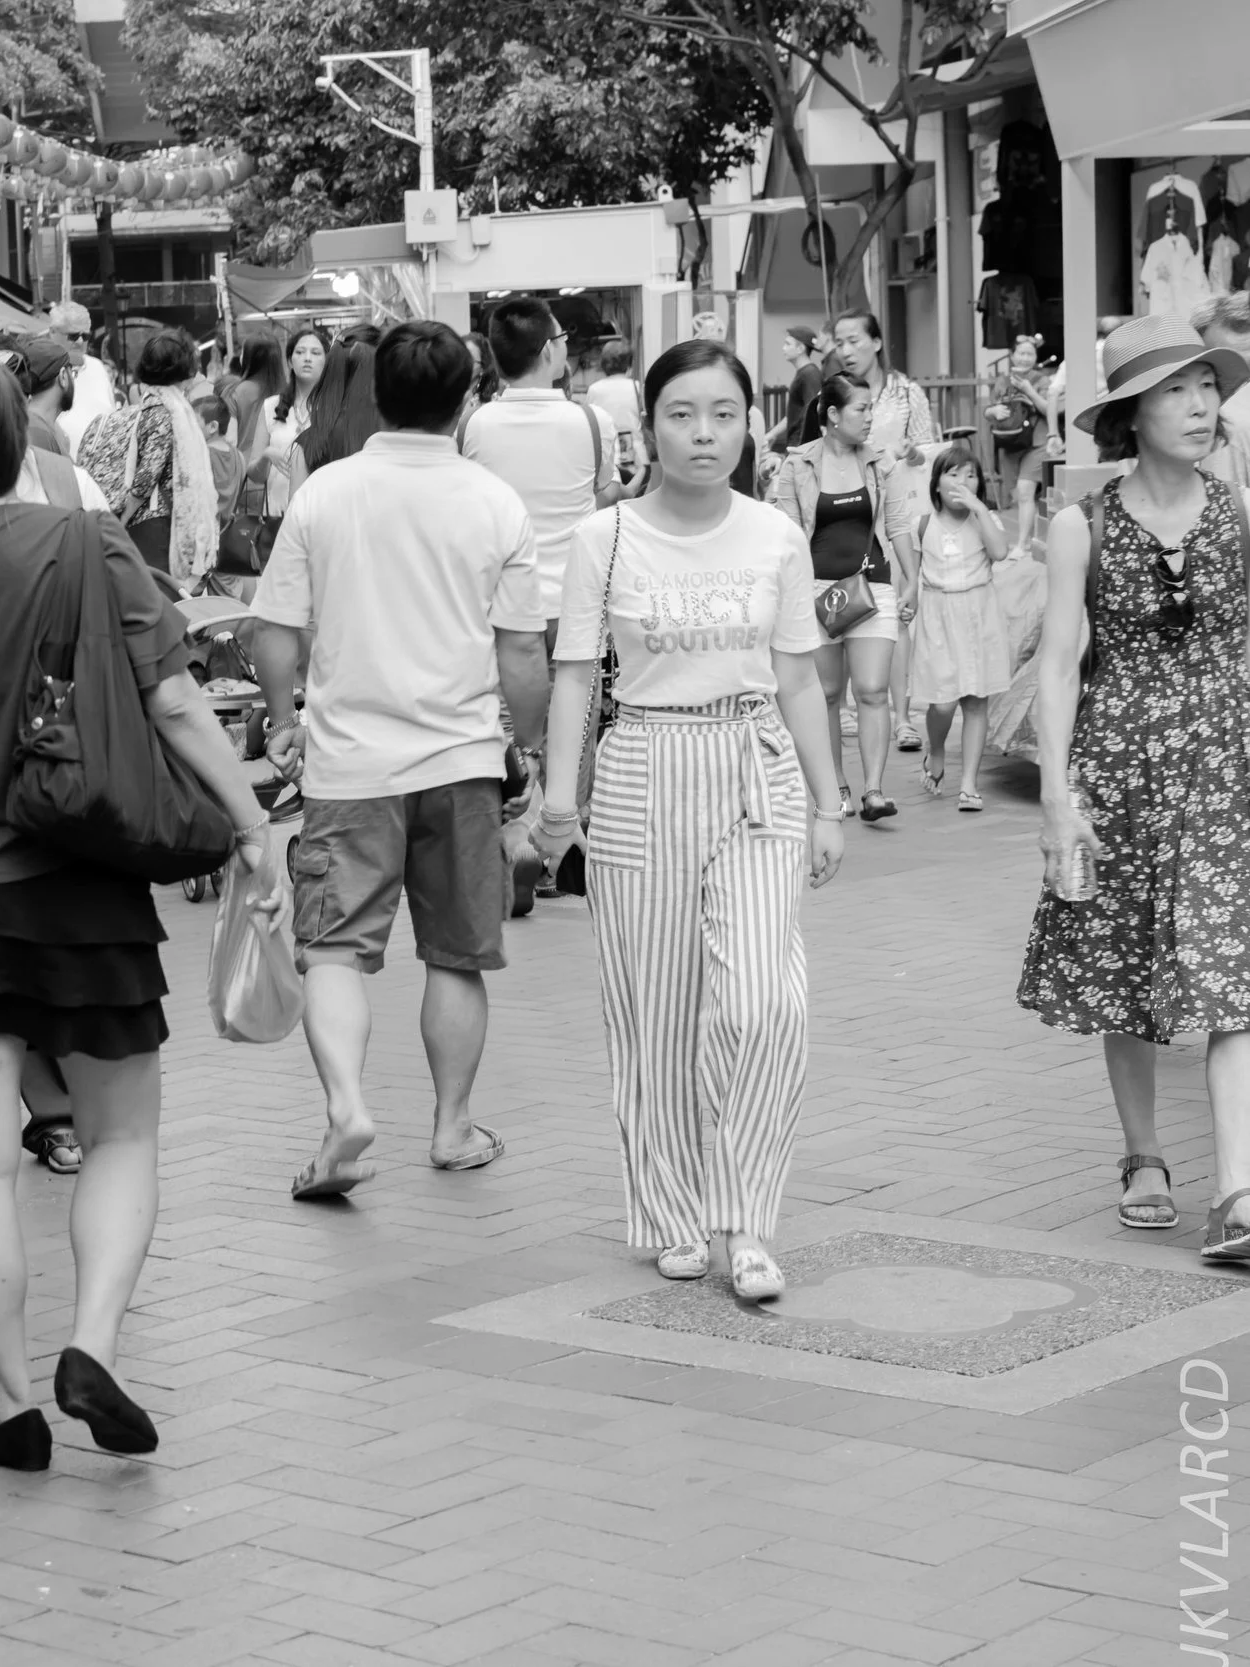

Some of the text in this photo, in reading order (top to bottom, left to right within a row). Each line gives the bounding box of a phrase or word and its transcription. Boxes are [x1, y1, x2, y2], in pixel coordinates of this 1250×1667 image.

[633, 567, 756, 593] GLAMOROUS
[640, 586, 754, 631] JUICY
[644, 626, 759, 654] COUTURE
